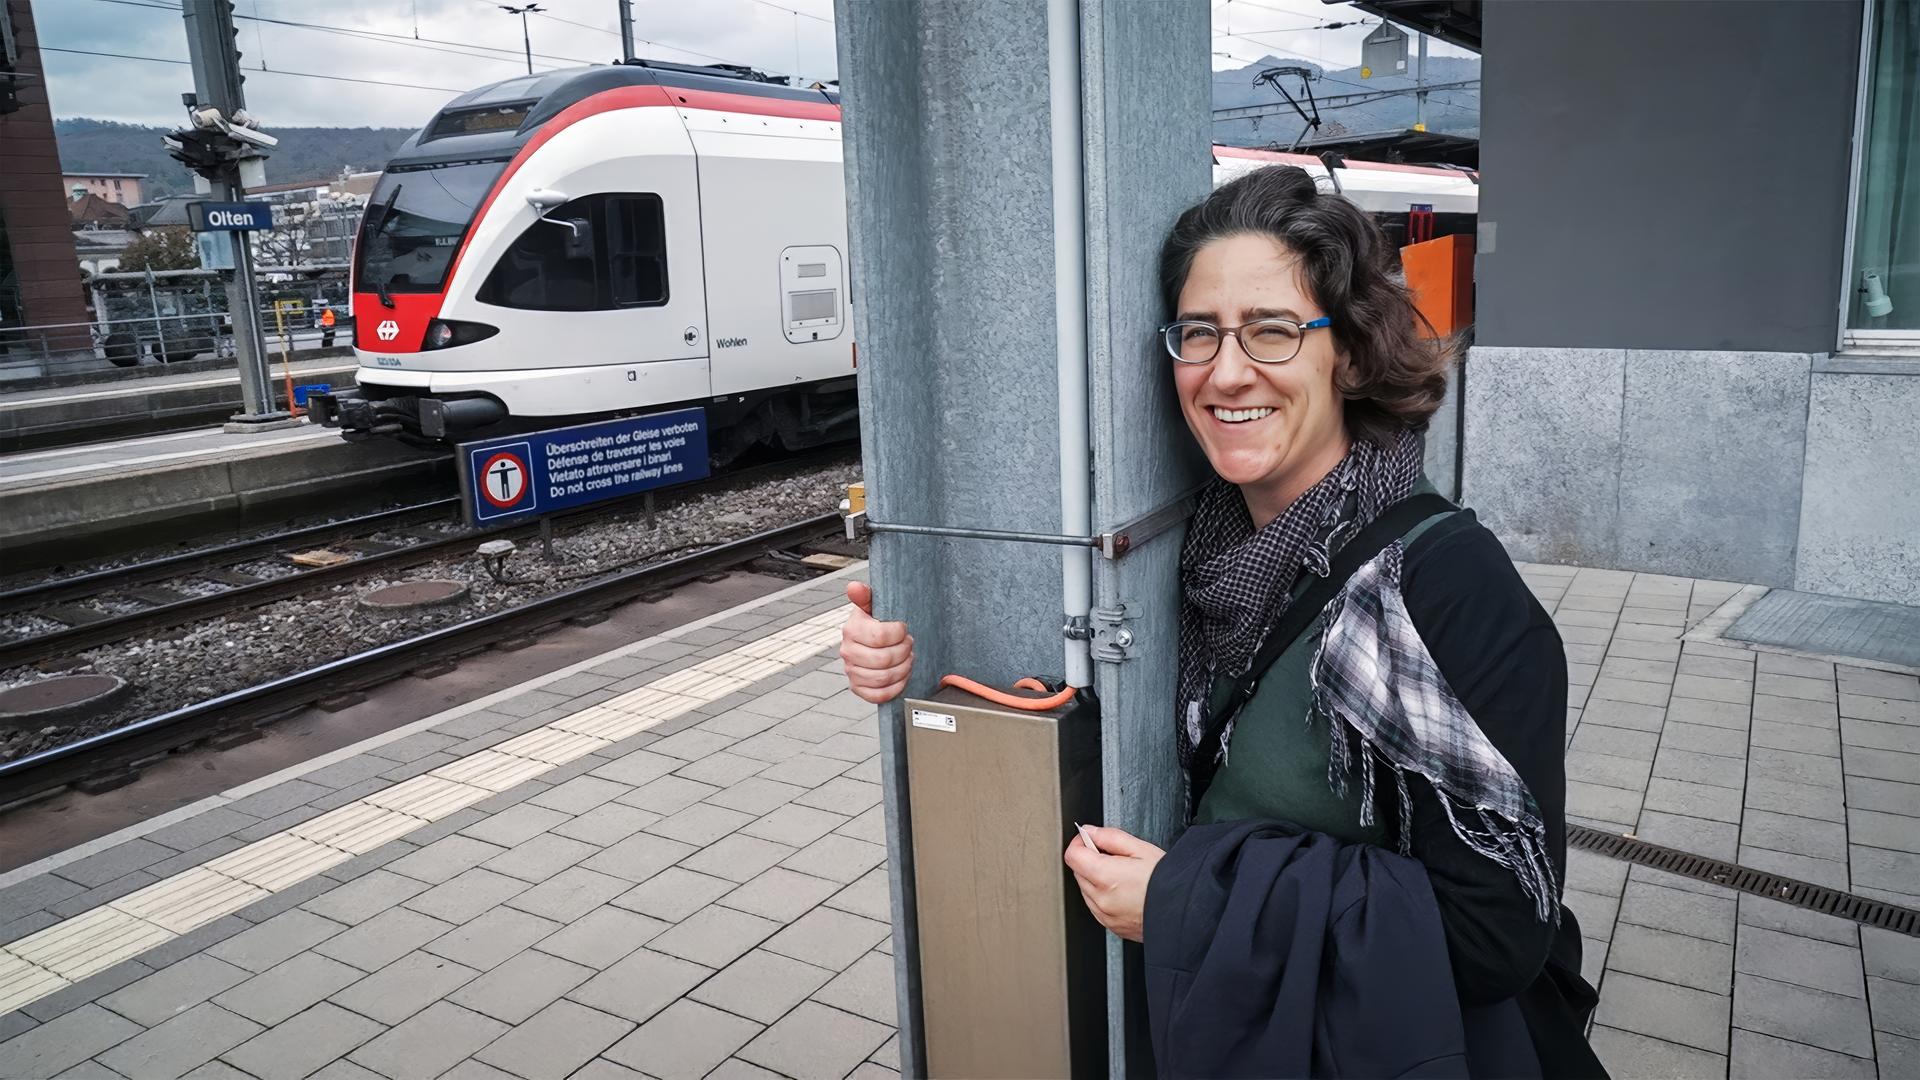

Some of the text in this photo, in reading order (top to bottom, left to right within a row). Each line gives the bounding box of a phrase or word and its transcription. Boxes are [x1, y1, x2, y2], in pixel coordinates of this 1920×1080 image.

[208, 210, 254, 226] Olten
[716, 337, 748, 348] Wohlen
[546, 421, 698, 456] Überschreiten der Gleise verboten
[548, 437, 686, 470] Défense de traverser les voies
[549, 468, 585, 484] Vietato
[586, 458, 642, 476] attraversare
[648, 450, 672, 465] binari
[550, 463, 683, 498] Do not cross the railway lines
